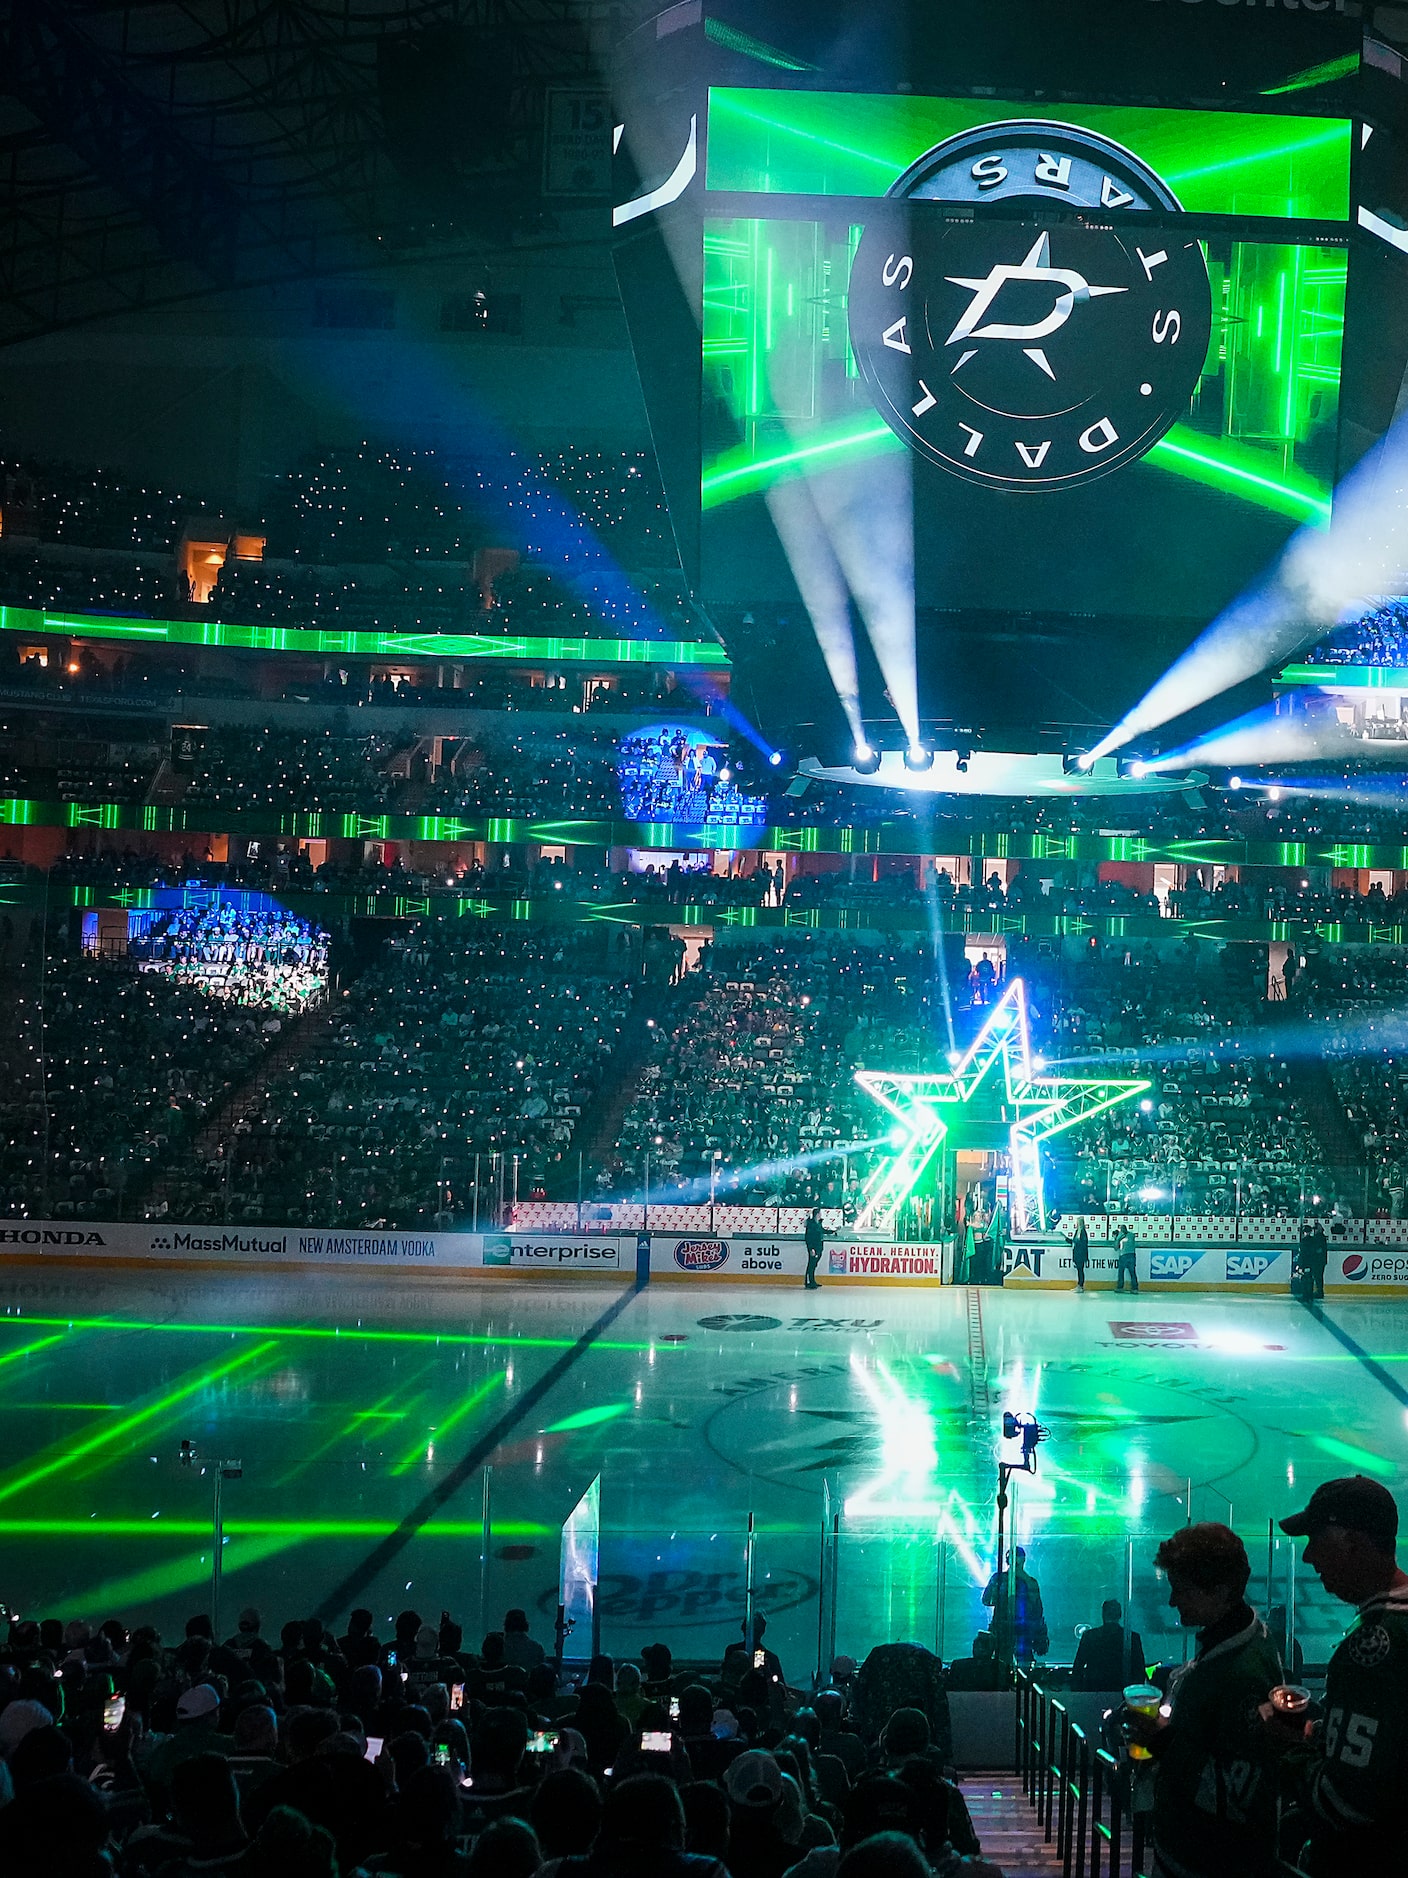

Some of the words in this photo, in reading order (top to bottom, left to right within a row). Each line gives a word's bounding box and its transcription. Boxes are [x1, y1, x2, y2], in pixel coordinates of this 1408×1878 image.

[0, 1230, 106, 1246] HONDA
[173, 1233, 287, 1253] MassMutual
[299, 1237, 324, 1254] NEW
[326, 1238, 398, 1256] AMSTERDAM
[401, 1240, 435, 1257] VODKA
[488, 1244, 617, 1262] enterprise
[681, 1241, 723, 1254] Jersey
[744, 1248, 752, 1256] a
[756, 1245, 780, 1257] sub
[849, 1246, 887, 1256] CLEAN.
[890, 1247, 939, 1257] HEALTHY.
[741, 1257, 782, 1270] above
[849, 1257, 938, 1275] HYDRATION.
[1092, 1258, 1105, 1268] THE
[1151, 1255, 1193, 1275] SAP
[1226, 1256, 1269, 1276] SAP
[788, 1317, 886, 1328] TXU
